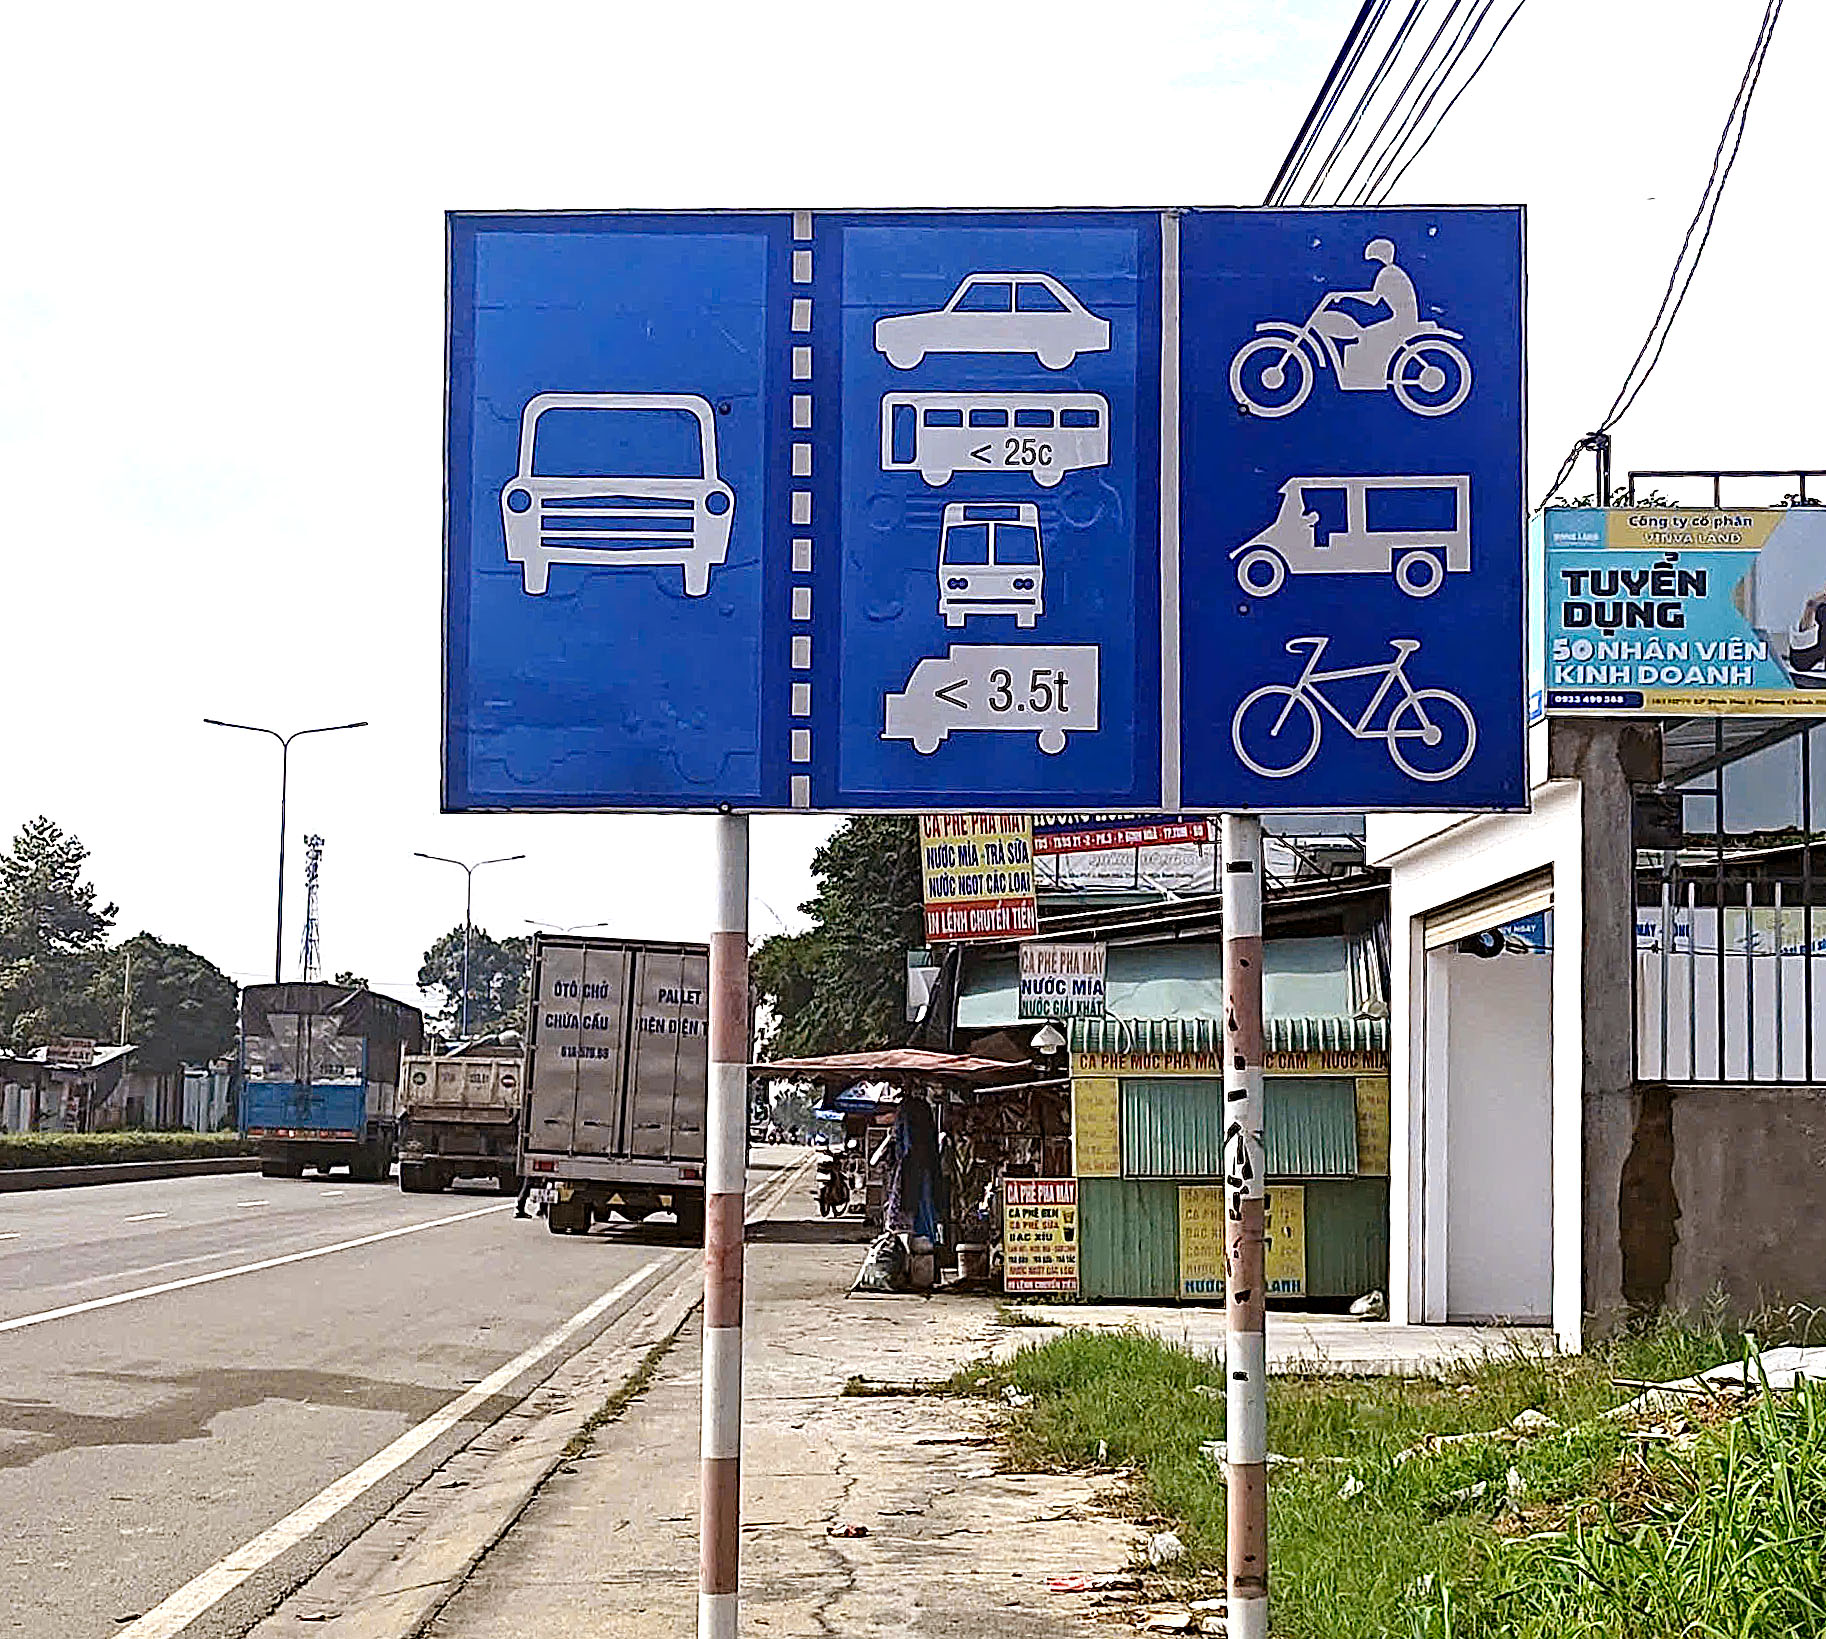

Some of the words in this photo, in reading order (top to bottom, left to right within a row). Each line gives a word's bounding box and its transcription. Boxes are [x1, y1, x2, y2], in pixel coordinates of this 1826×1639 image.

[1004, 438, 1053, 466] 25c
[1628, 514, 1673, 530] Công
[1673, 516, 1687, 530] ty
[1713, 514, 1753, 528] phần
[1643, 532, 1694, 546] VINVA
[1698, 532, 1742, 545] LAND
[1561, 551, 1708, 598] TUYỂN
[1562, 601, 1686, 637] DỤNG
[1552, 637, 1594, 662] 50
[1597, 636, 1691, 662] NHÂN
[1694, 636, 1769, 662] VIÊN
[1554, 664, 1633, 686] KINH
[1637, 664, 1755, 687] DOANH
[988, 669, 1069, 712] 3.5t
[926, 841, 956, 869] NƯỚC
[983, 838, 1006, 865] TRÀ
[1007, 837, 1030, 864] SỮA
[928, 871, 956, 898] NƯỚC
[985, 869, 1007, 895] CÁC
[1008, 872, 1031, 897] LOẠI
[926, 910, 940, 935] IN
[941, 906, 968, 938] LỆNH
[1060, 950, 1080, 974] PHA
[658, 988, 702, 1005] PALLET
[1021, 975, 1067, 996] NƯỚC
[1021, 996, 1051, 1017] NƯỚC
[1164, 1053, 1190, 1070] PHA
